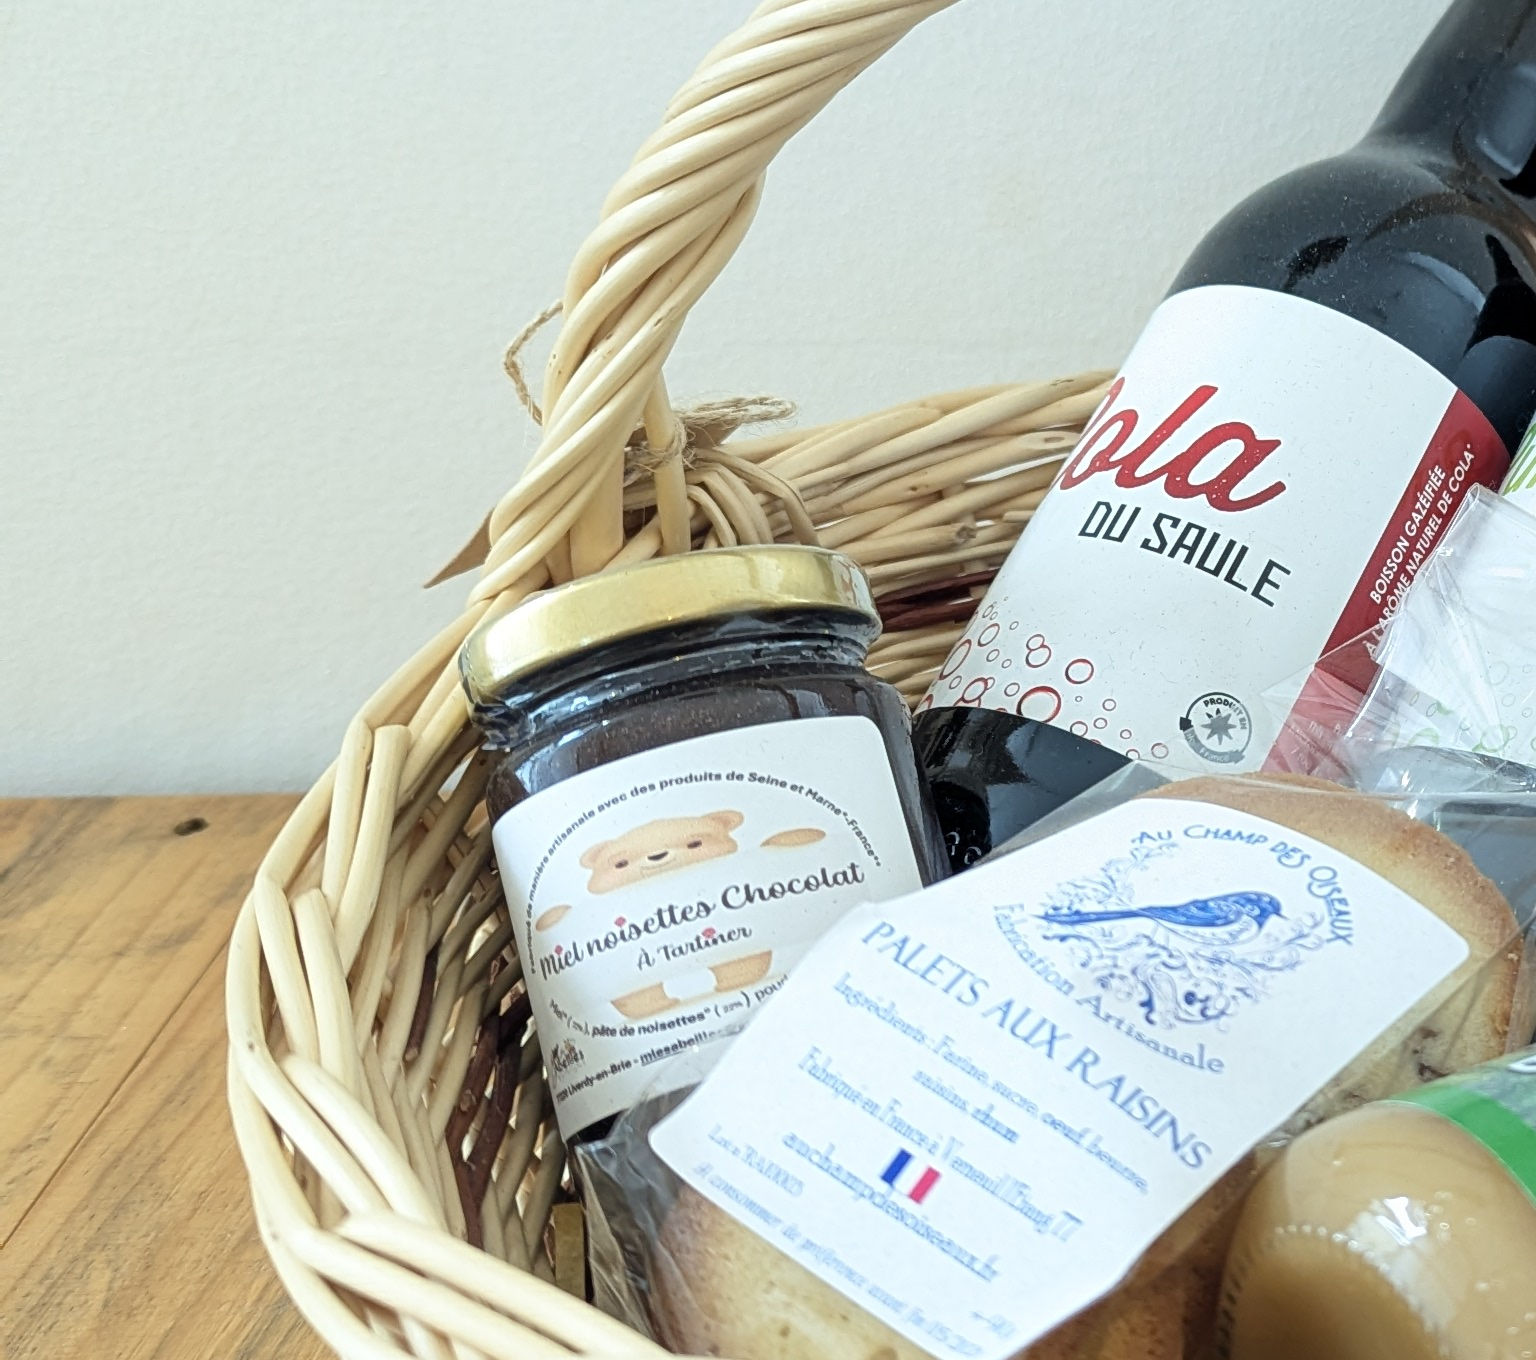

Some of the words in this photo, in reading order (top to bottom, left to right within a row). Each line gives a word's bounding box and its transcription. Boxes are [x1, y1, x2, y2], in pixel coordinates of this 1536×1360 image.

[1054, 376, 1287, 512] ola
[1077, 500, 1142, 543] DU
[1139, 512, 1291, 608] SAULE
[1370, 536, 1410, 604] BOISSON
[1405, 464, 1447, 537] GAZÉIFIÉE
[1405, 513, 1443, 580] NATUREL
[1436, 492, 1454, 516] DE
[548, 809, 596, 857] artisanale
[597, 792, 628, 814] avec
[630, 783, 657, 799] des
[659, 771, 722, 791] produits
[725, 771, 745, 782] de
[747, 772, 788, 789] Seine
[789, 782, 805, 795] et
[586, 898, 717, 957] noisettes
[721, 861, 866, 910] Chocolat
[1183, 824, 1269, 846] CHAMP
[1270, 840, 1312, 869] DES
[1307, 865, 1354, 946] OISEAUX
[656, 925, 752, 962] Tartiner
[619, 1024, 636, 1038] de
[861, 919, 991, 1009] PALETS
[980, 997, 1073, 1061] AUX
[1064, 1045, 1213, 1171] RAISINS
[1076, 994, 1226, 1074] Artisanale
